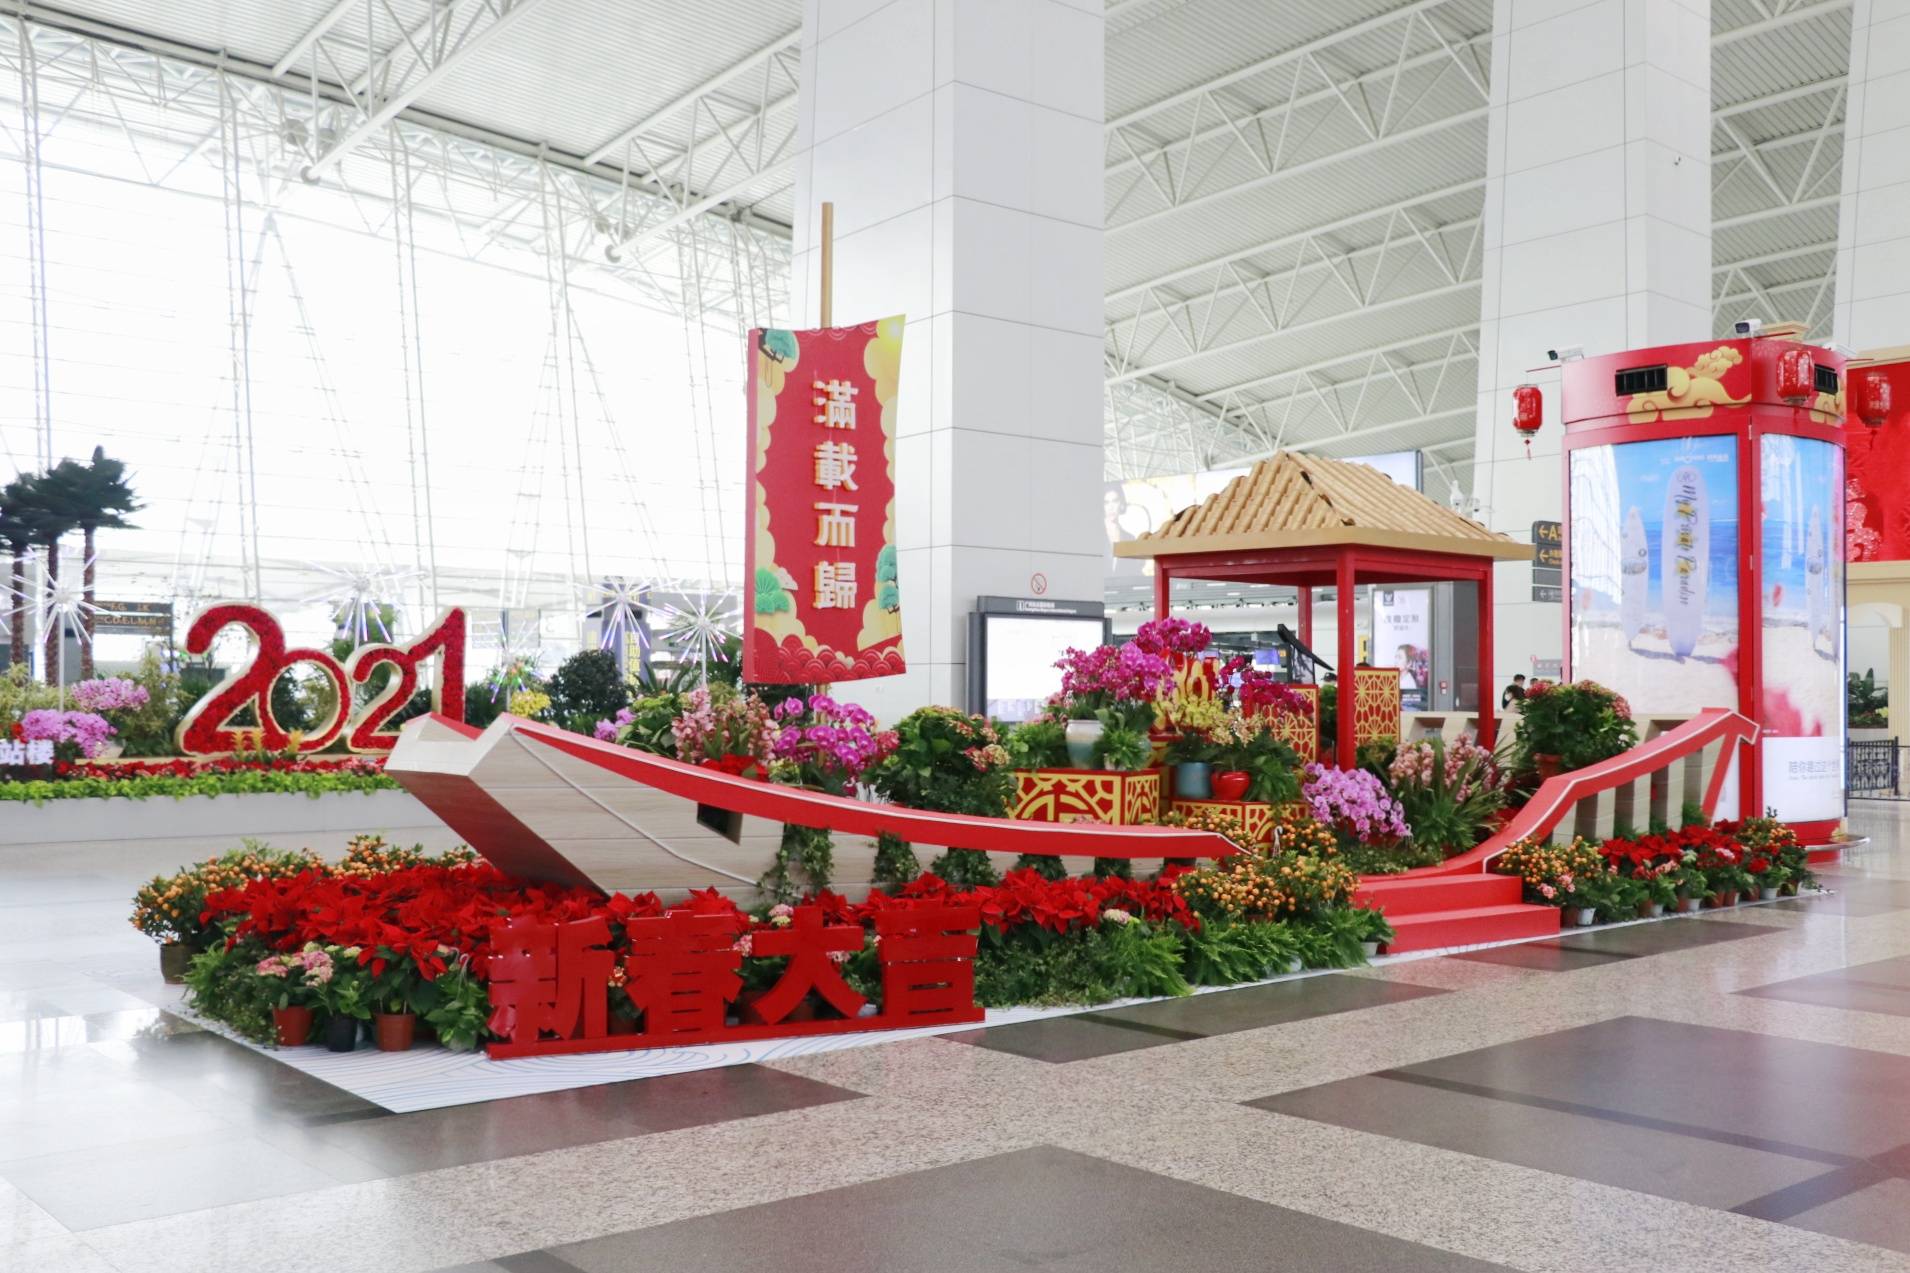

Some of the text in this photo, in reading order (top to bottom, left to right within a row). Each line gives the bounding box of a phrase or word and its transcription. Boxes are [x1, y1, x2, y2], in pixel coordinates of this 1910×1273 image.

[812, 379, 859, 610] 滿載而歸
[175, 600, 467, 753] 2021
[486, 903, 980, 1042] 新春大吉
